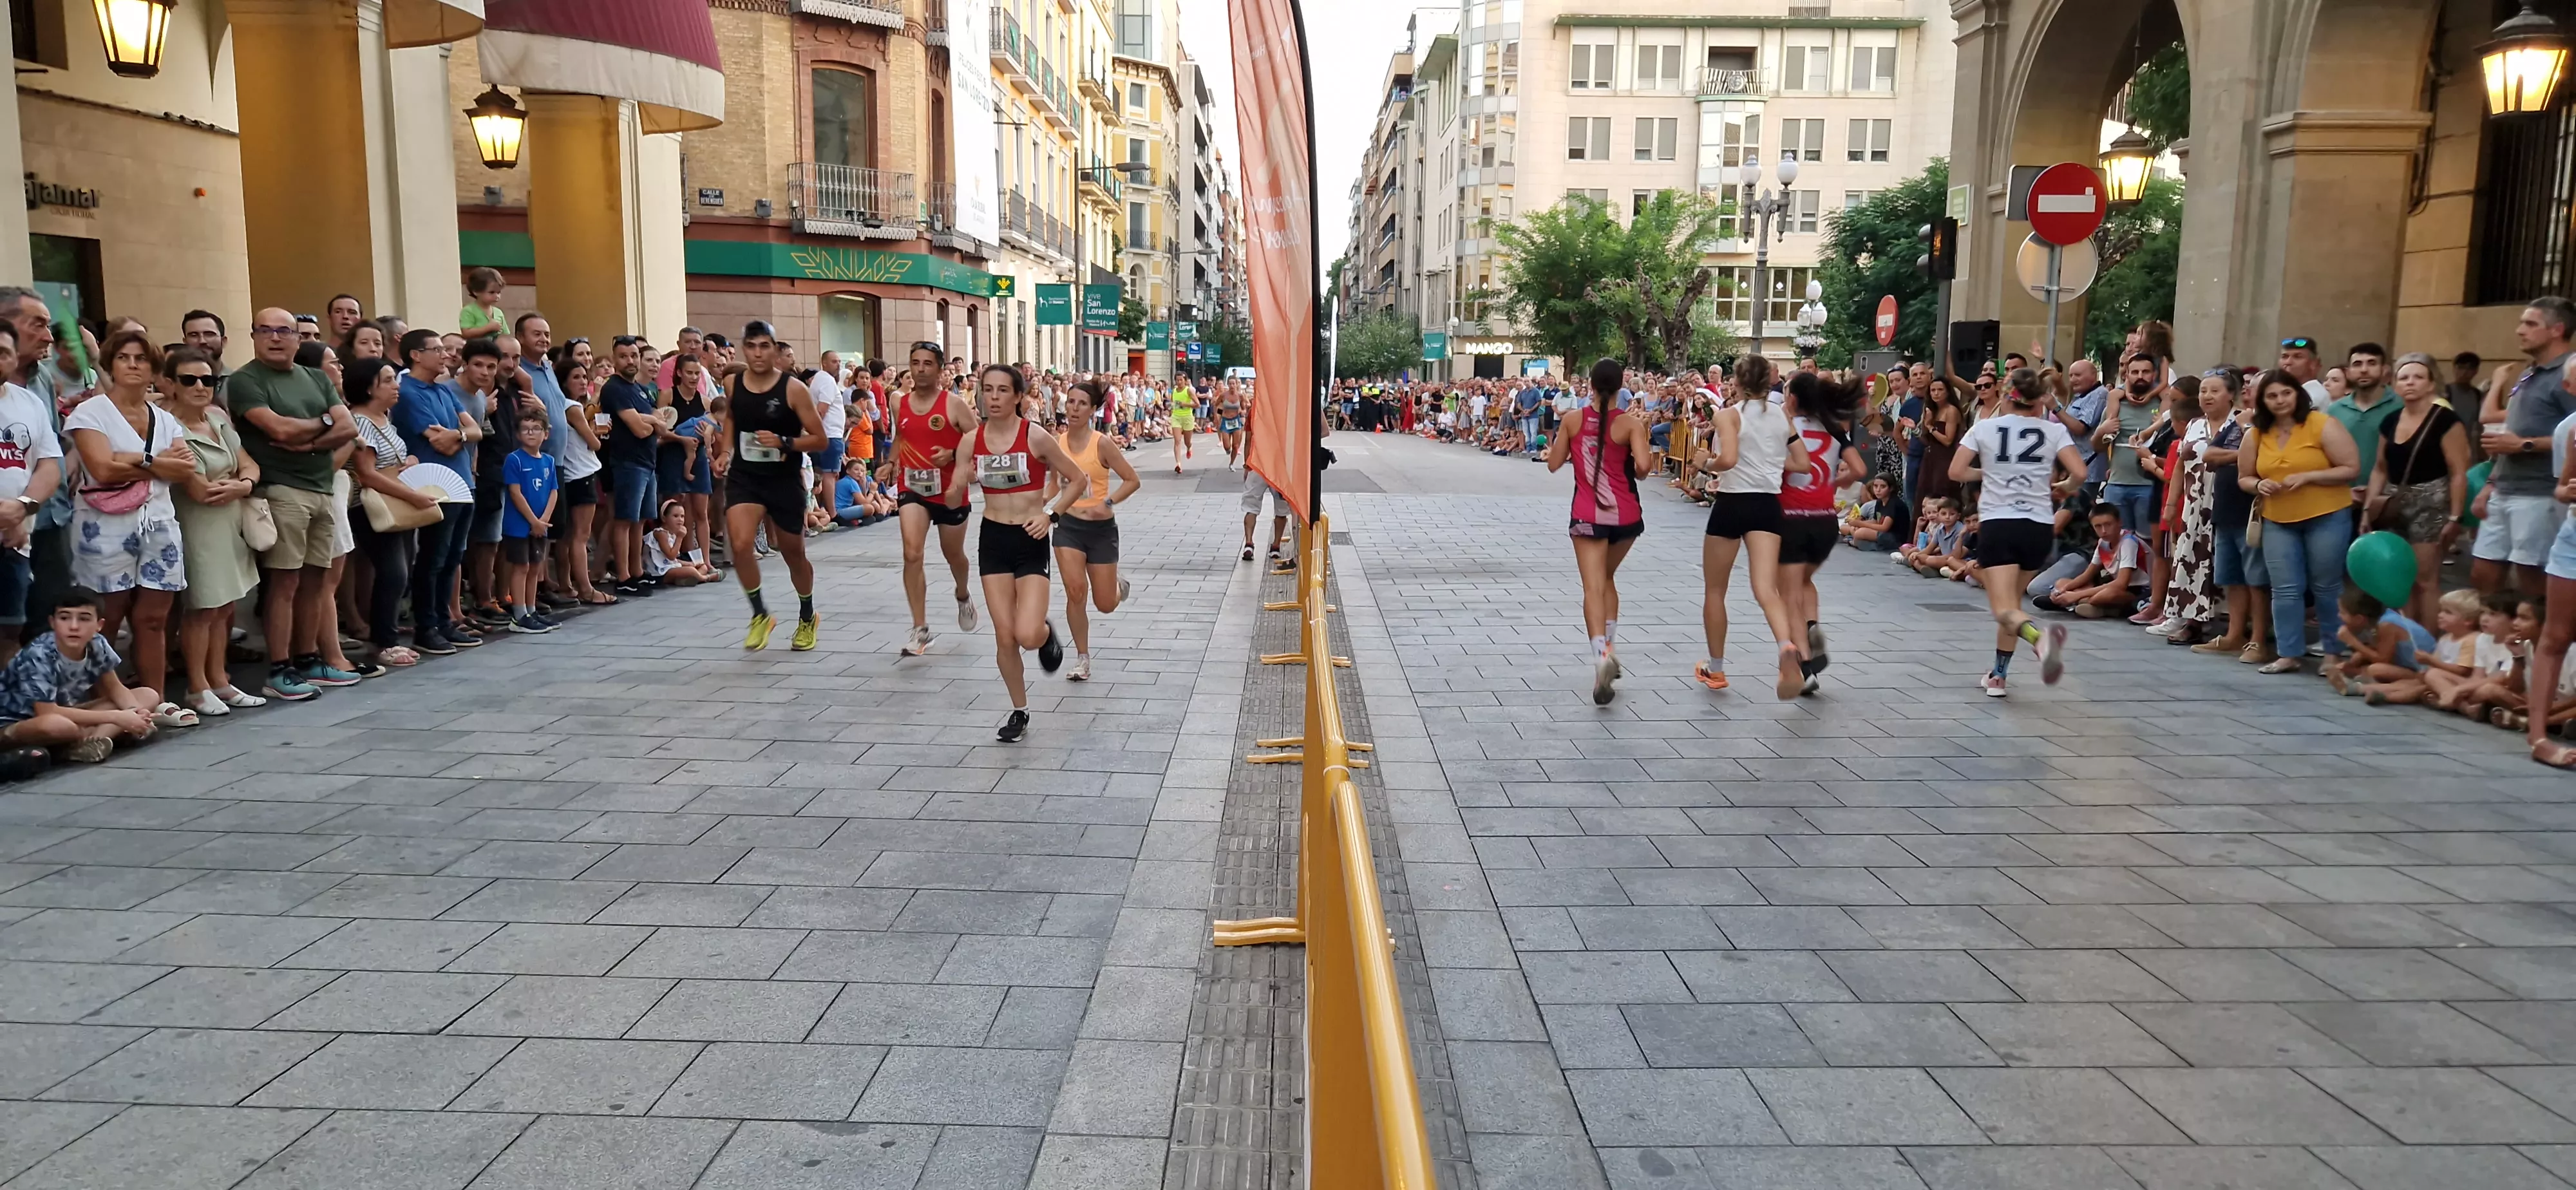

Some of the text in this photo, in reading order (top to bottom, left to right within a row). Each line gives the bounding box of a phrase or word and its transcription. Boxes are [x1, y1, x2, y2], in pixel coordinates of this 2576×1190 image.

[1087, 299, 1101, 307] San
[1087, 307, 1115, 316] Lorenzo
[1466, 342, 1513, 354] MANGO
[1995, 426, 2045, 464] 12
[992, 455, 1010, 468] 28
[913, 470, 928, 479] 14
